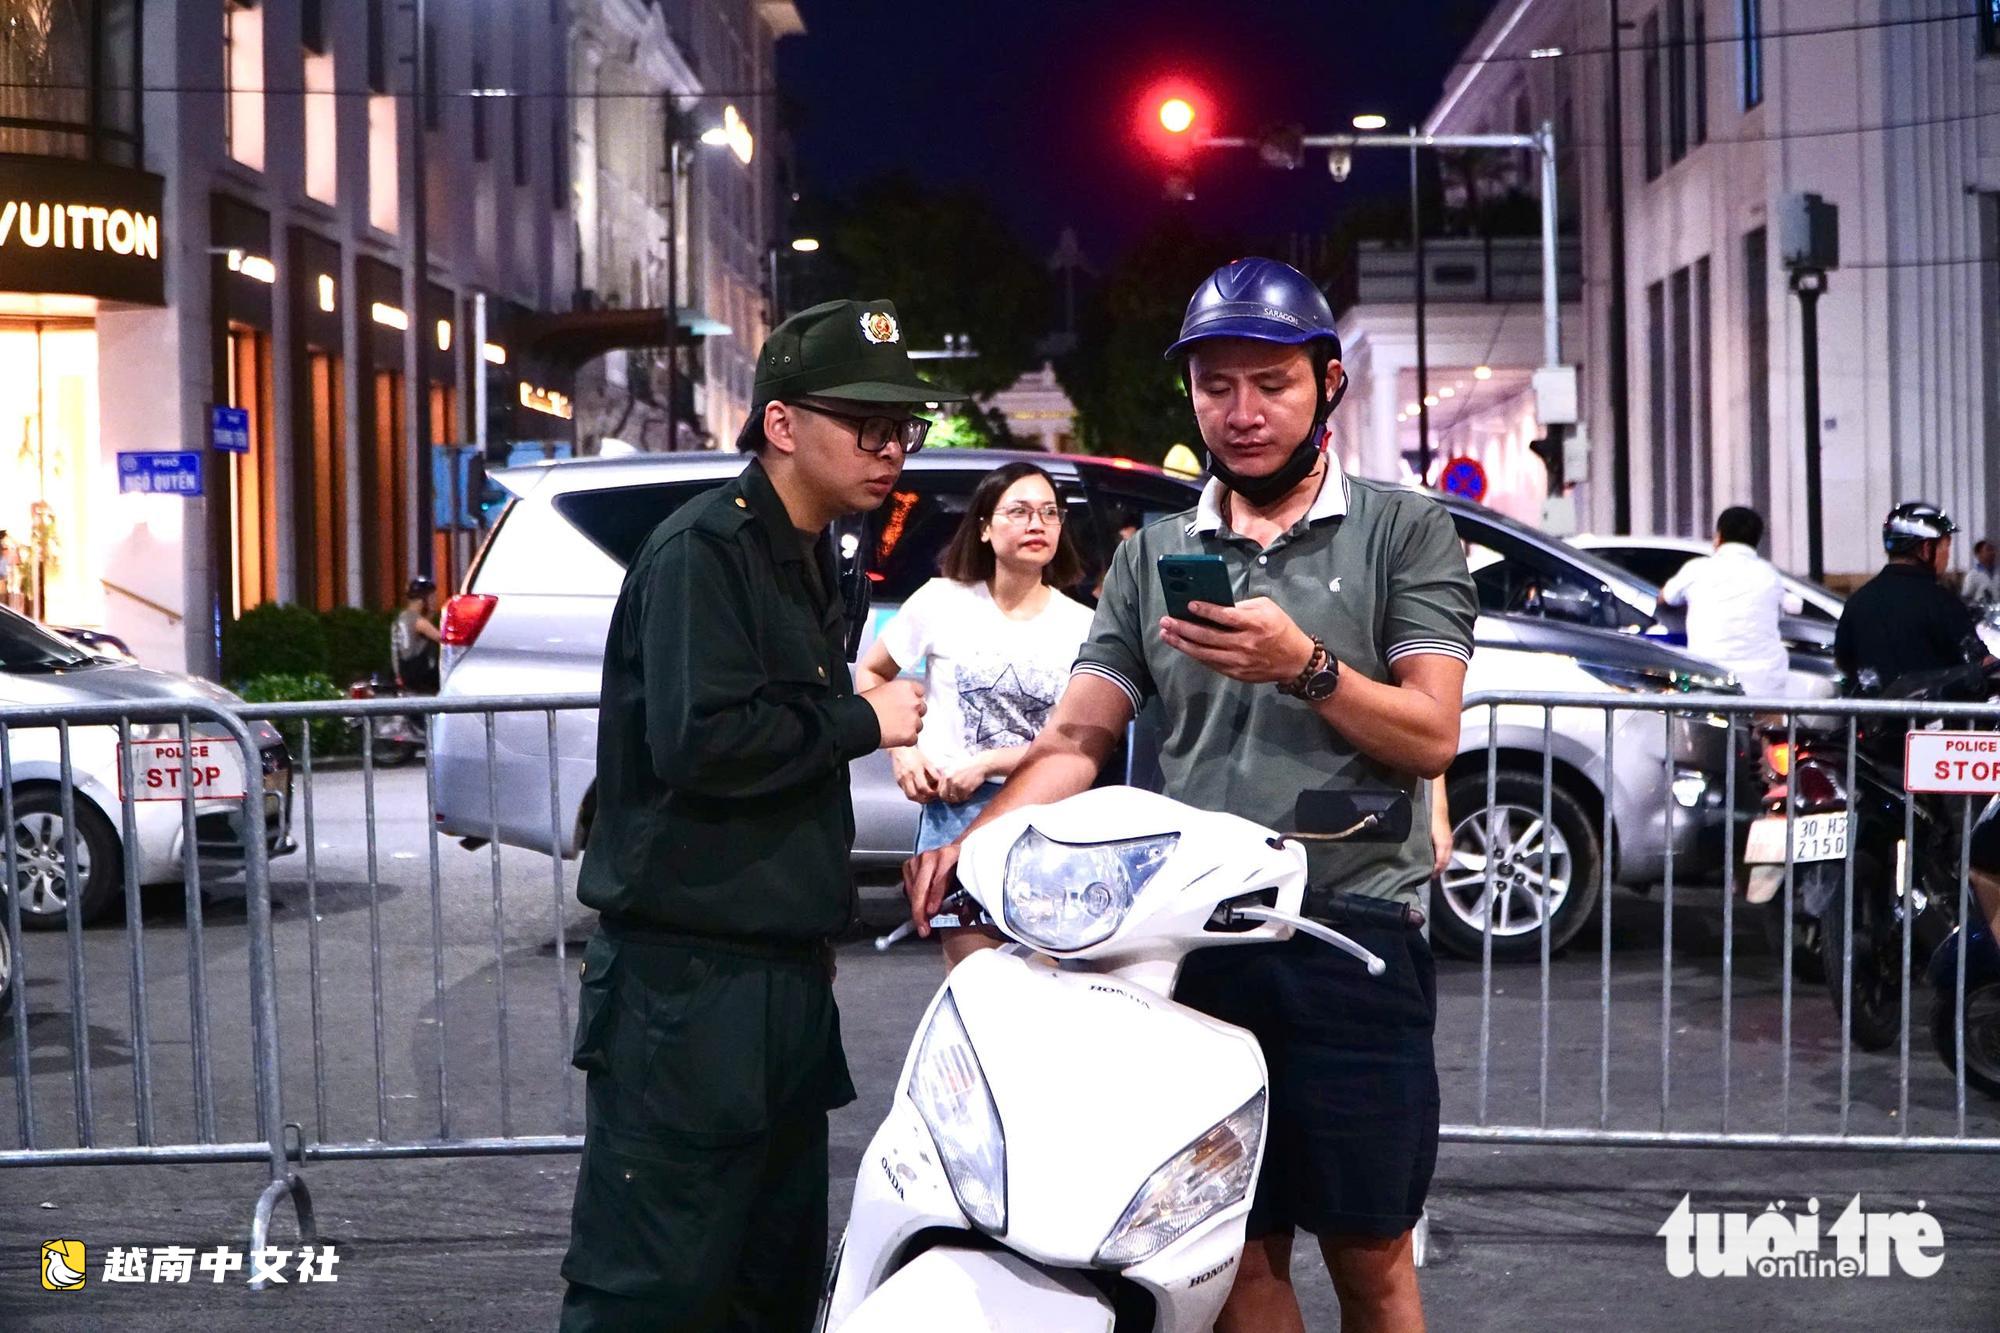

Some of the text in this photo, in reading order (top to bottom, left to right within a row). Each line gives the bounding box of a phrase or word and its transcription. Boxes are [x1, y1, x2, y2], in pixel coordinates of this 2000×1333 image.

[155, 746, 208, 759] POLCE
[1946, 740, 1997, 753] POLICE
[147, 766, 220, 788] STOP
[1797, 837, 1844, 859] 2150
[1188, 1256, 1234, 1289] HONDA
